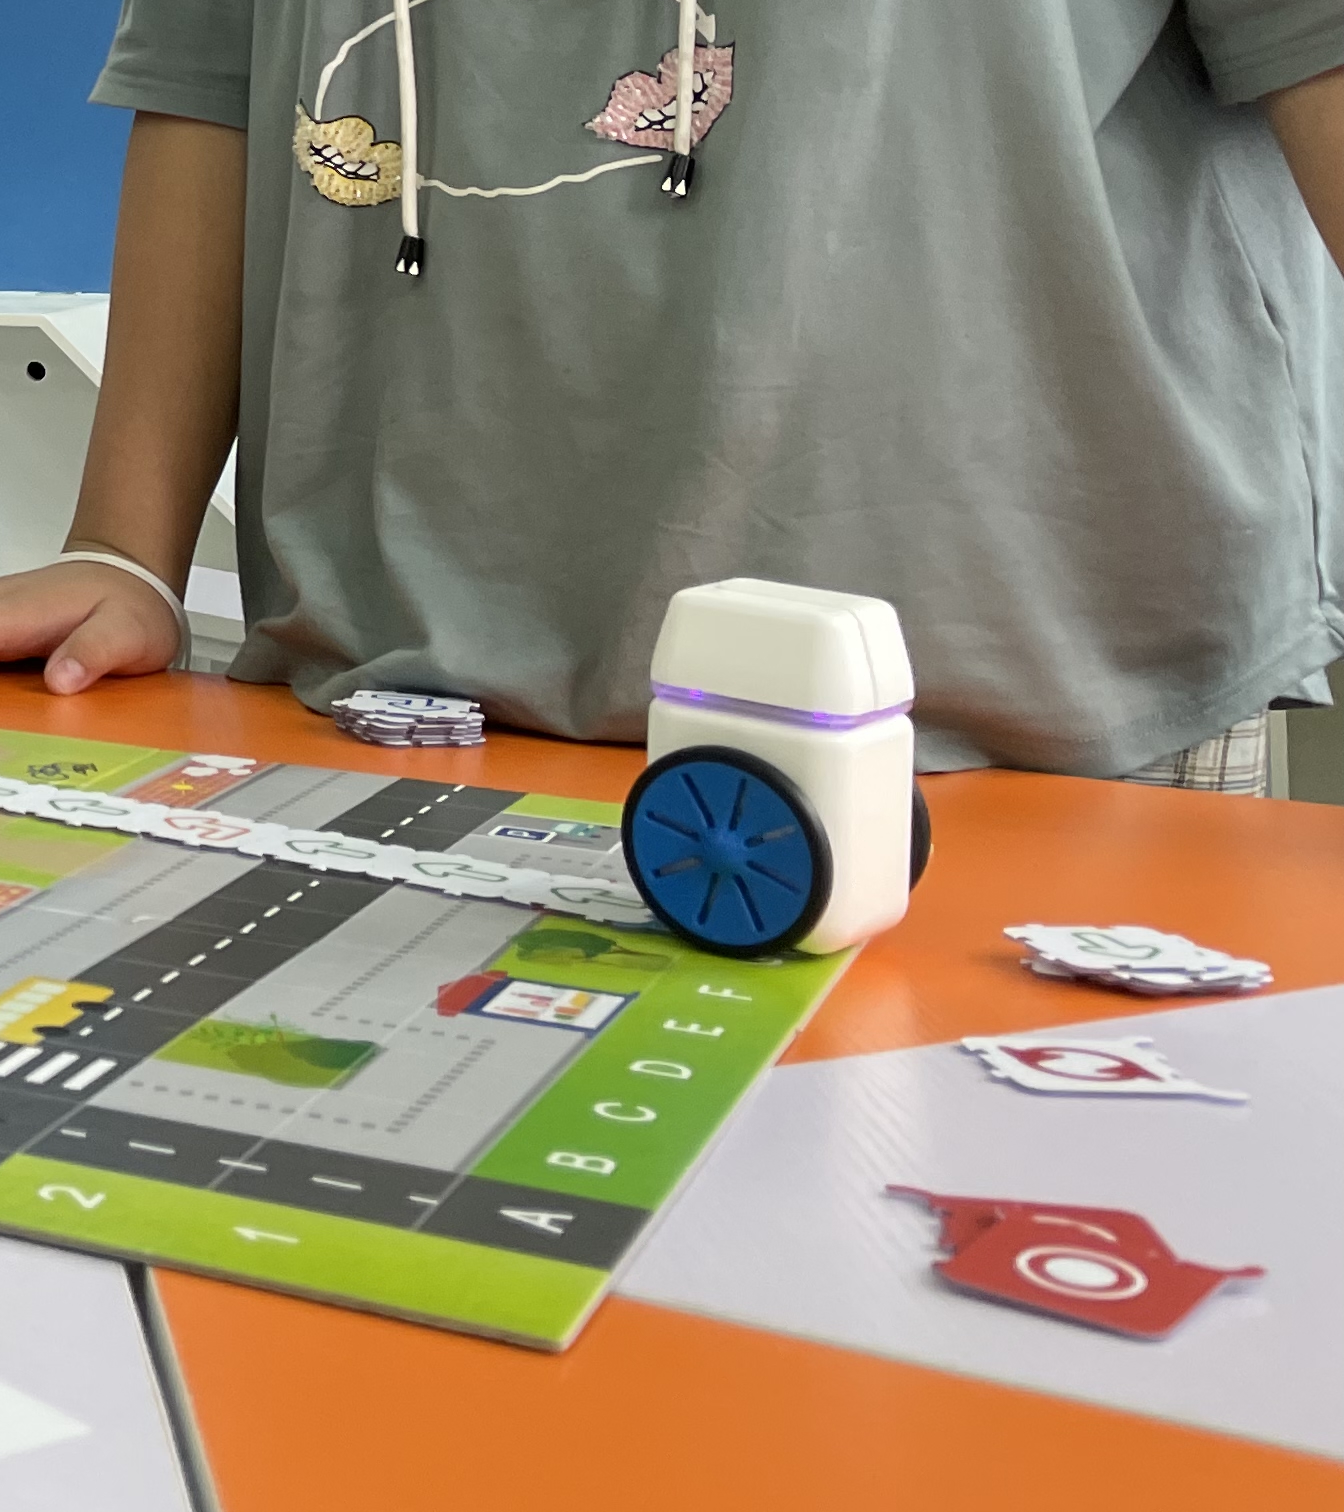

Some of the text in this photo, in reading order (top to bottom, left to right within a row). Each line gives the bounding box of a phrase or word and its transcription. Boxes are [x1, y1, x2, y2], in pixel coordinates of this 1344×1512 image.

[498, 984, 753, 1235] A B C D E F
[38, 1184, 107, 1209] 2
